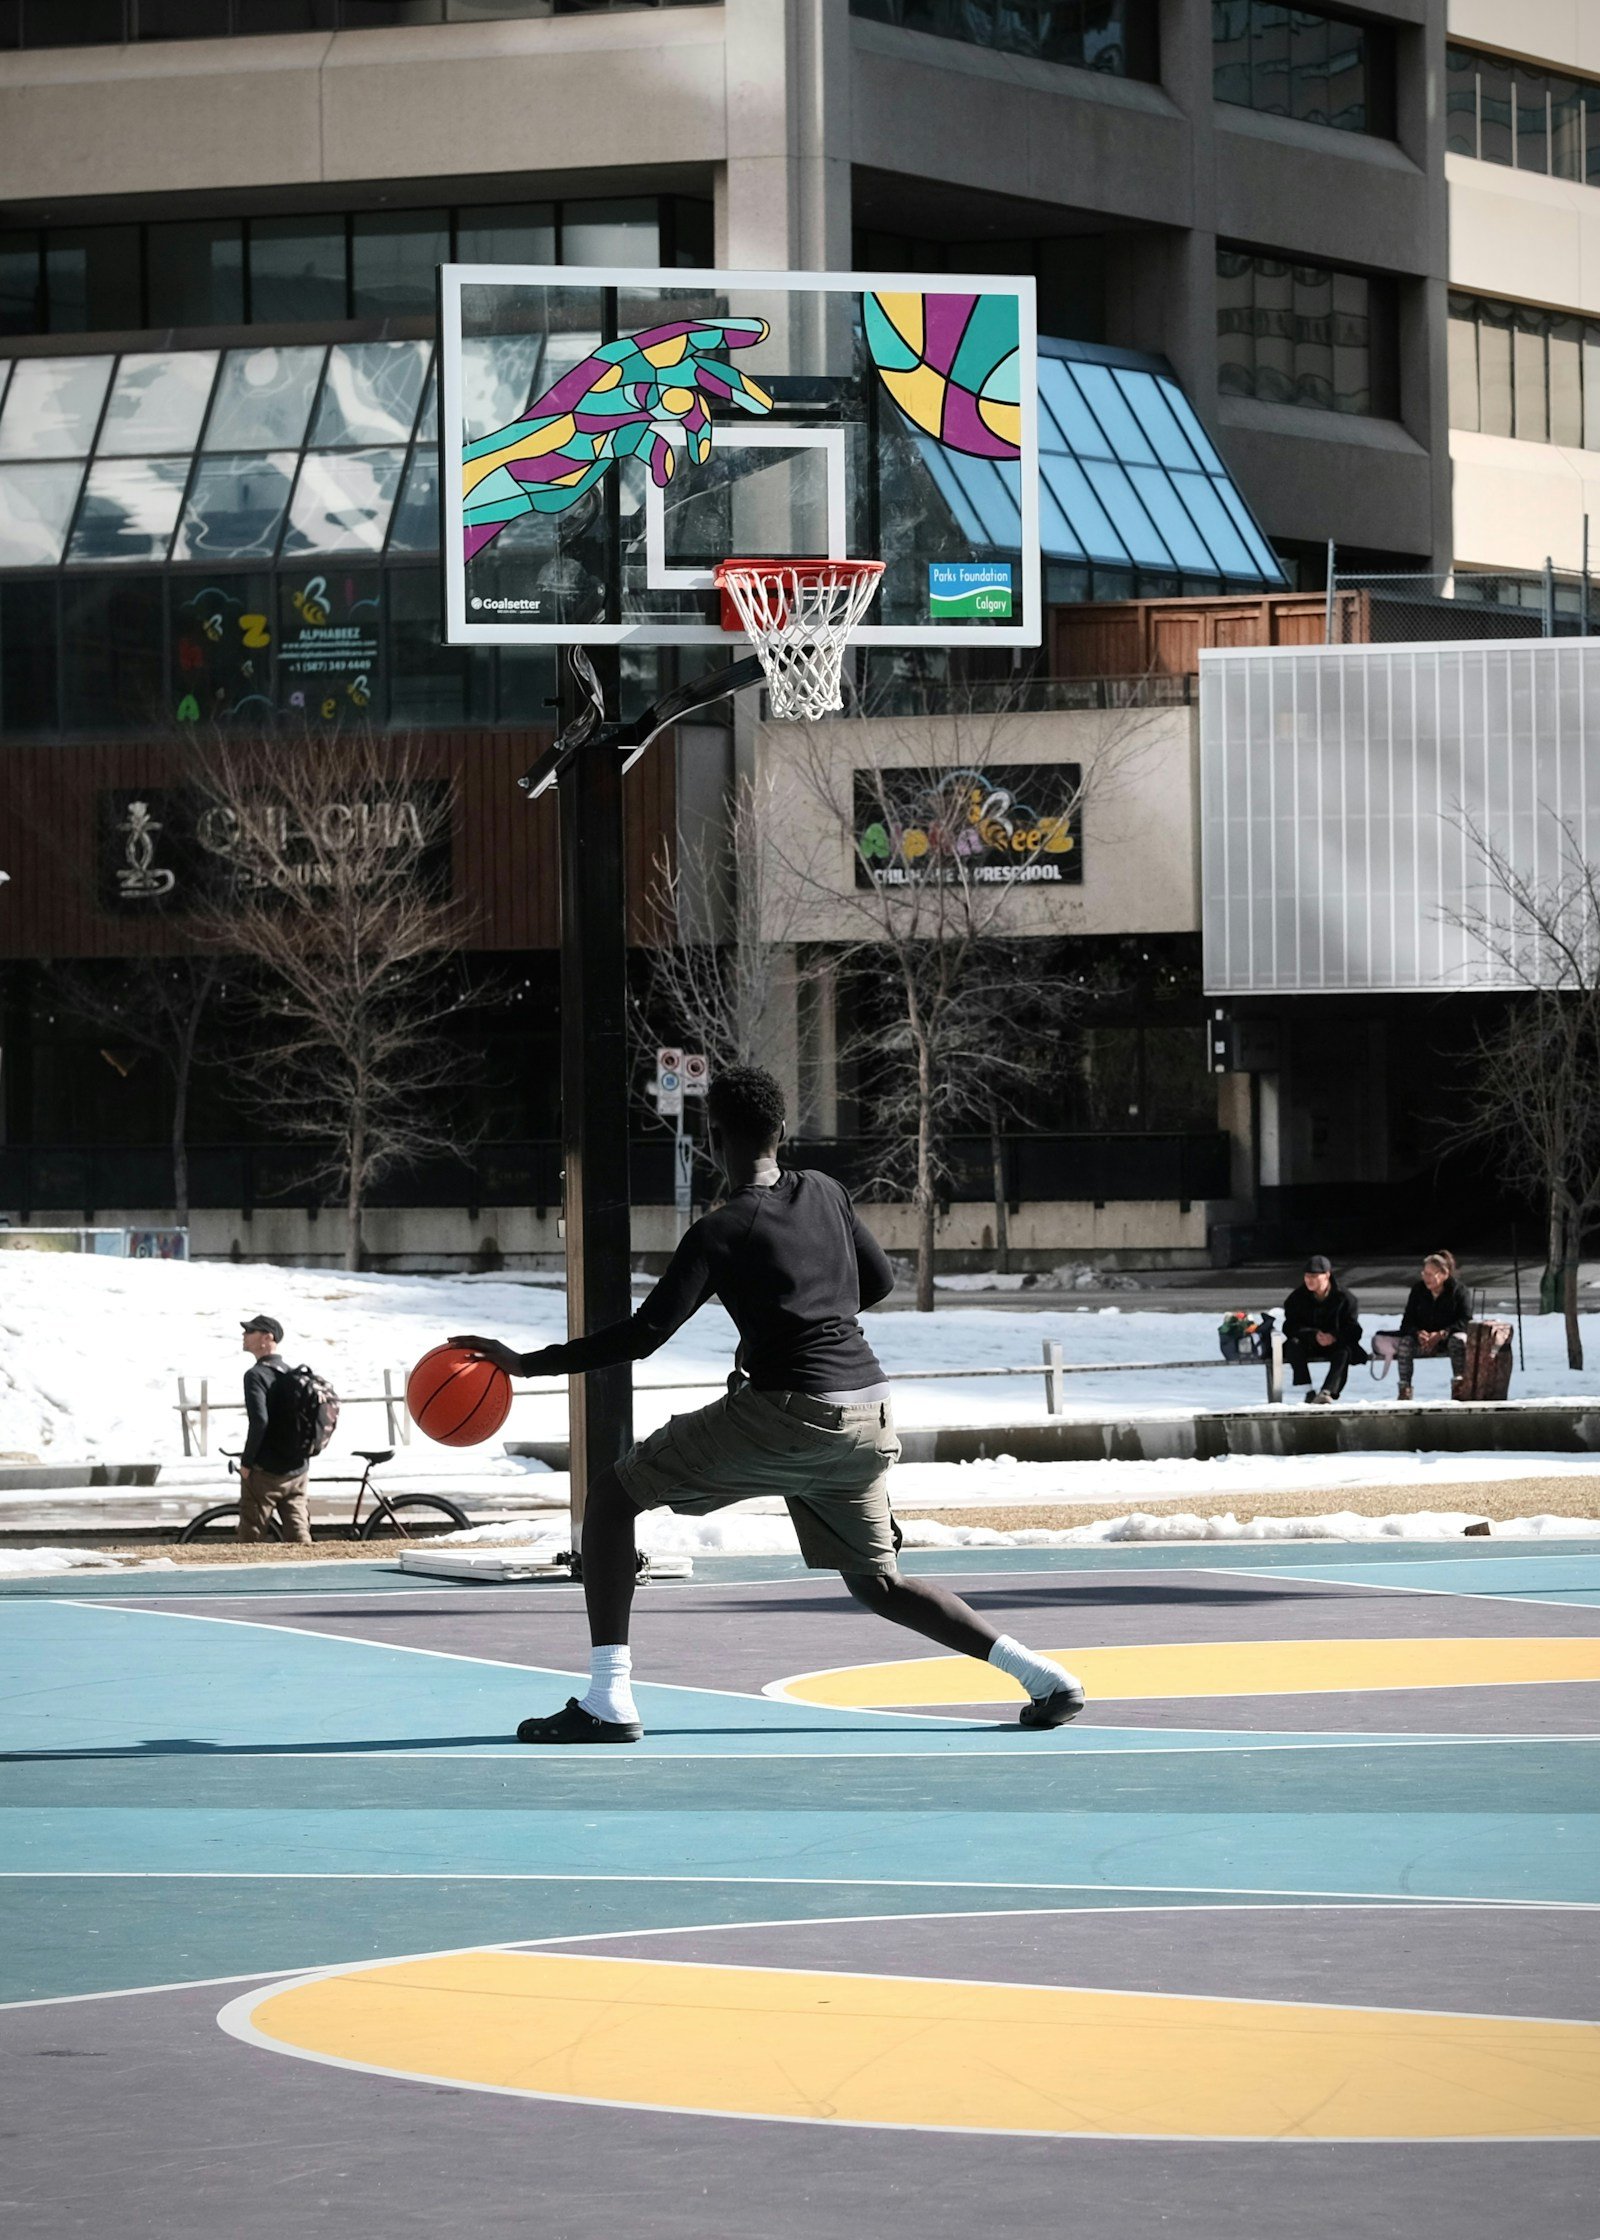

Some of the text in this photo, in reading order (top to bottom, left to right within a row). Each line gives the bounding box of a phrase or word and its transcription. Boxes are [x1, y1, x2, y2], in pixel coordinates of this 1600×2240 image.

[934, 568, 1008, 582] Parks Foundation
[483, 598, 541, 610] Goalsetter
[976, 596, 1007, 612] Calgary
[299, 627, 360, 640] ALPHABEEZ
